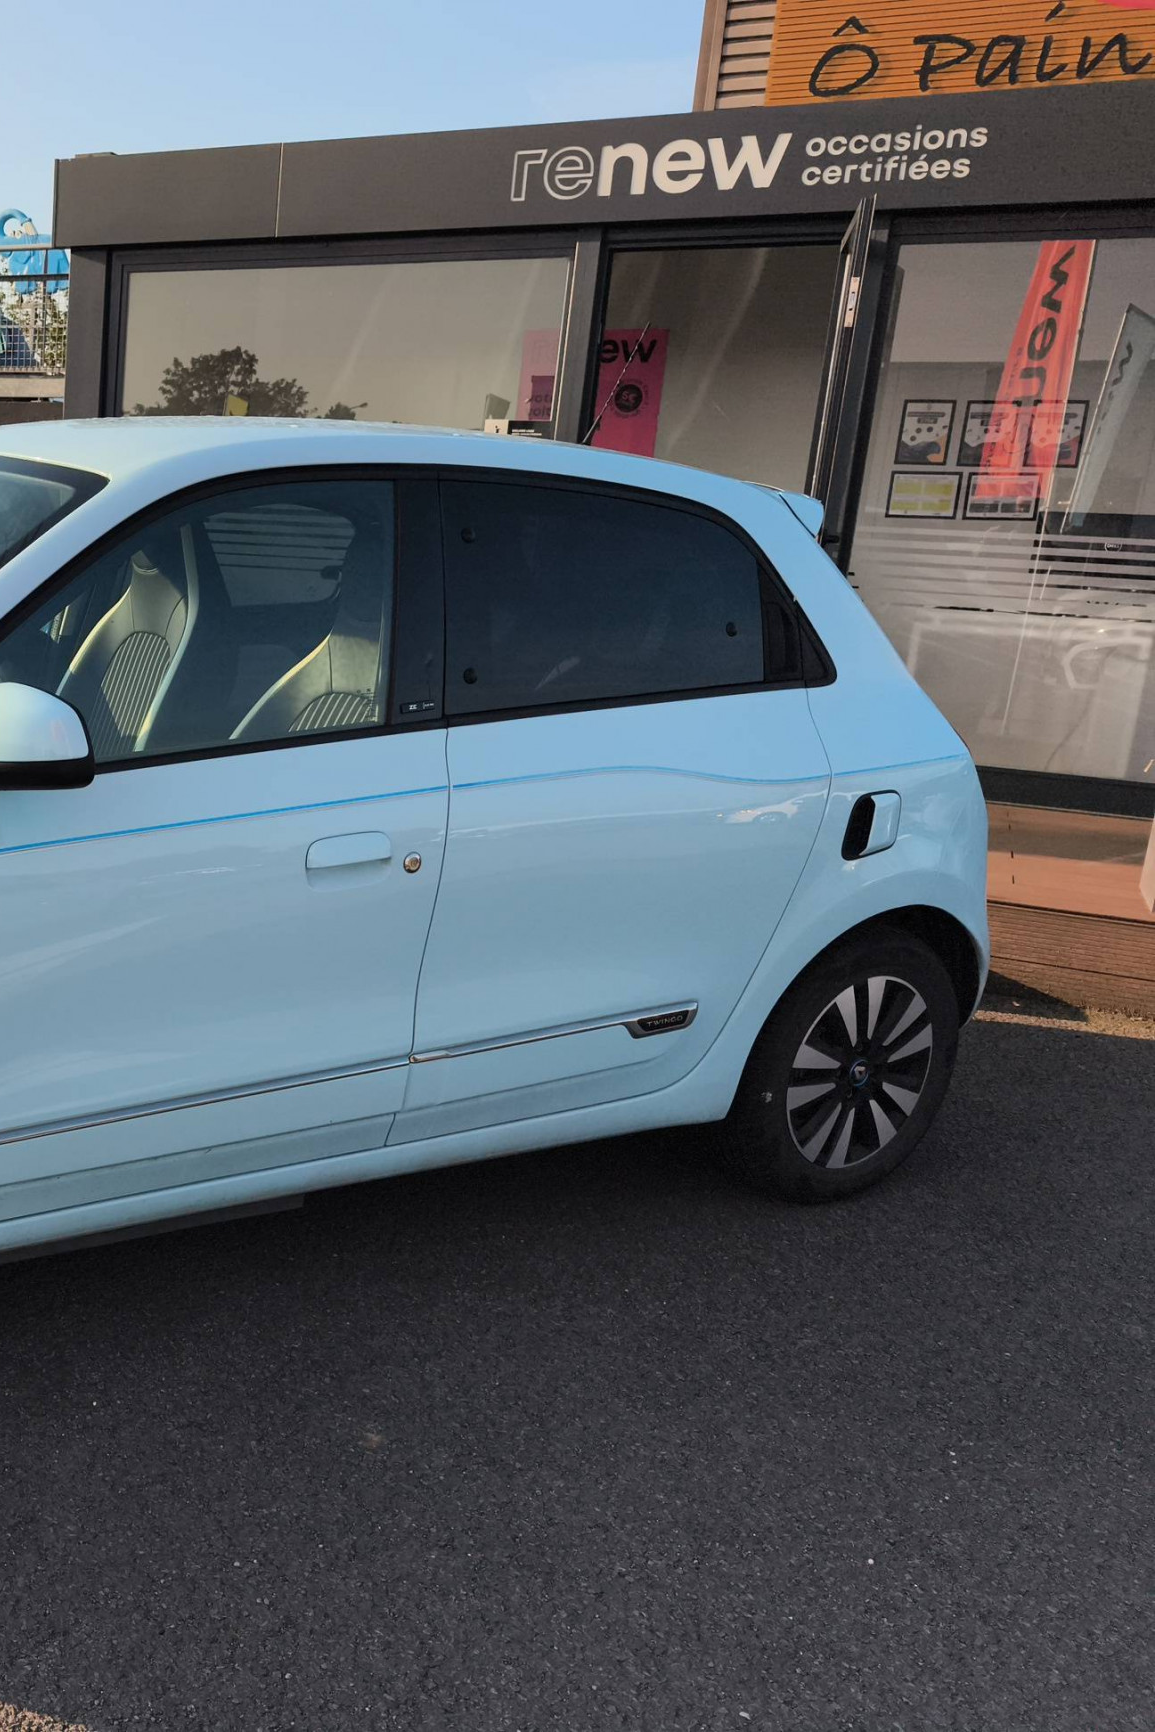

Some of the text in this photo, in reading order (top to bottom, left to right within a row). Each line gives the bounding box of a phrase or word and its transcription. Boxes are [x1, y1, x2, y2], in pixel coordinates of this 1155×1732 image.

[809, 16, 880, 97] Ô
[805, 124, 988, 157] occasions
[510, 132, 793, 201] renew
[800, 152, 971, 186] certifiées
[600, 339, 658, 364] ew
[647, 1015, 684, 1028] TWINGO
